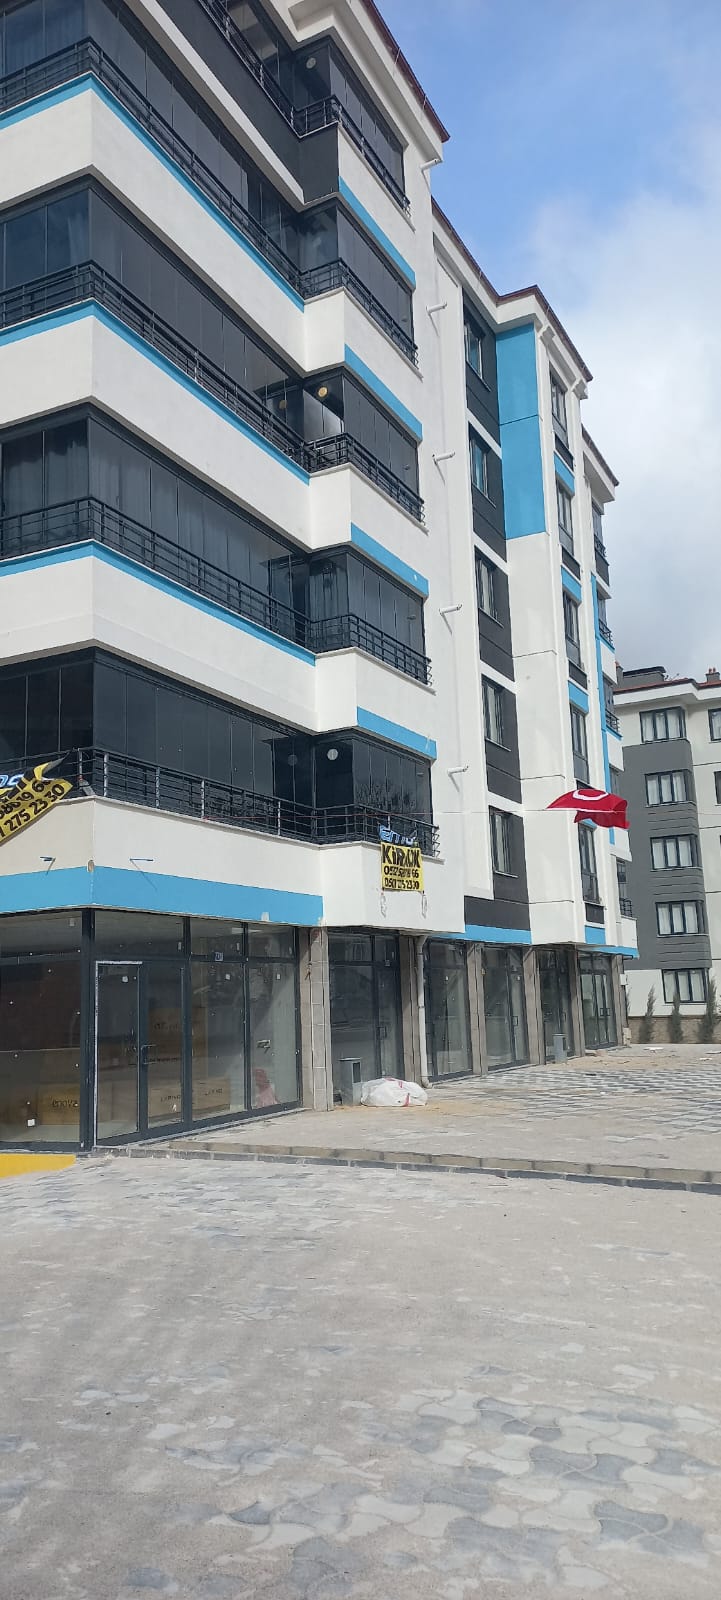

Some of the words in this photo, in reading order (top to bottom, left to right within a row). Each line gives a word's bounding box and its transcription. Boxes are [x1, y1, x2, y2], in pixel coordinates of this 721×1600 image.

[3, 809, 31, 831] 275
[28, 799, 48, 815] 23
[44, 783, 65, 802] 30
